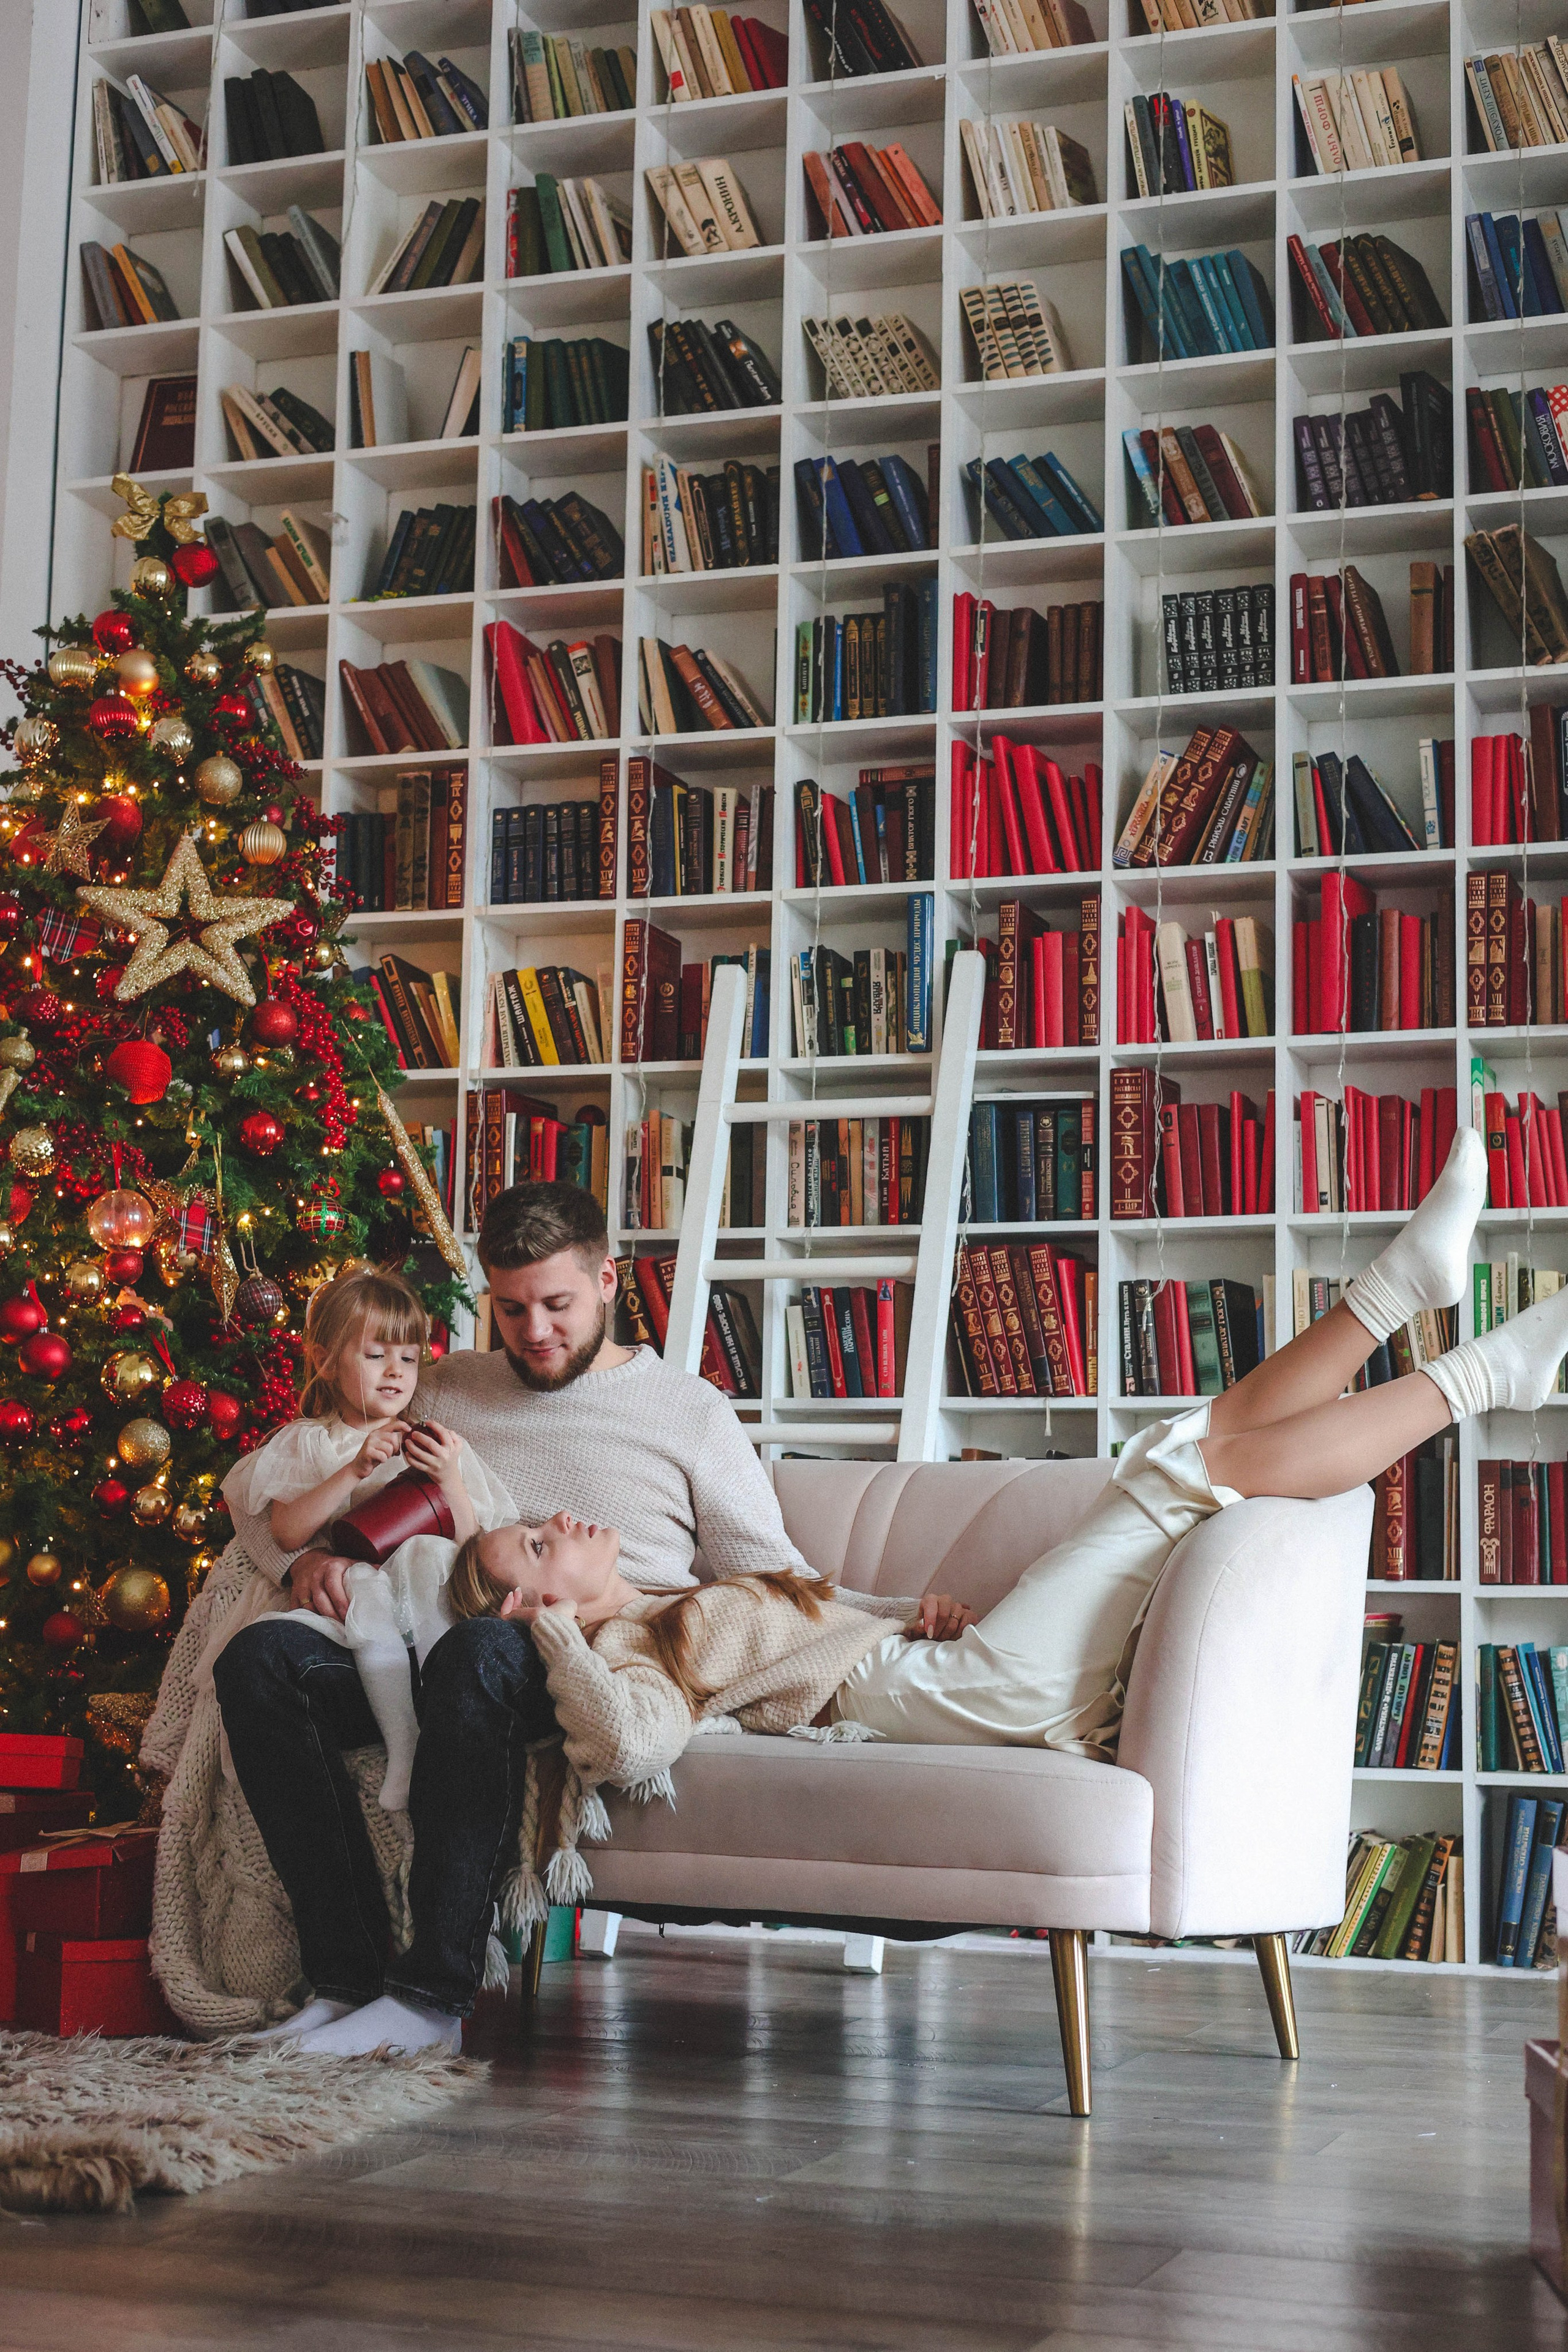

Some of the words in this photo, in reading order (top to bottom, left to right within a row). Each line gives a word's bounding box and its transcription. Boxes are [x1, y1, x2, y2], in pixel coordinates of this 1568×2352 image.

[1479, 75, 1493, 100] КЕНТ
[1313, 93, 1332, 132] ФОРШ
[1485, 100, 1504, 142] РОКУЭЛЛ
[1325, 132, 1342, 165] ОЛЬГА
[1008, 206, 1016, 216] 2
[1534, 414, 1560, 470] МОСКОВИЯ
[1206, 815, 1227, 849] РАФАЭЛЬ
[1218, 778, 1242, 817] САБАТИНИ
[1231, 815, 1254, 846] СТЮАРТ
[912, 940, 921, 964] ЧУДЕС
[744, 951, 758, 997] ТОЛСТЯКА
[496, 978, 506, 1008] КУХНЯ
[507, 983, 526, 1024] ШАНТАЖ
[911, 967, 920, 1031] ЭНЦИКЛОПЕДИЯ
[1474, 994, 1480, 1005] V
[1492, 993, 1502, 1004] VII
[745, 1001, 753, 1018] ТРИ
[1084, 1014, 1096, 1024] VIII
[1002, 1017, 1009, 1028] X
[499, 1009, 512, 1066] ЛАТЫШСКАЯ
[625, 1031, 633, 1041] IV
[1125, 1188, 1130, 1199] II
[717, 1312, 731, 1335] МОРЕ
[1215, 1299, 1226, 1325] ГЮГО
[724, 1334, 734, 1347] НА
[840, 1326, 850, 1353] ЗАКОНЫ
[842, 1309, 856, 1353] ПАРКИНСОНА
[1123, 1326, 1132, 1360] Сталин.
[1218, 1325, 1231, 1357] ВИКТОР
[728, 1346, 737, 1355] И
[813, 1336, 822, 1363] ПУШКИН
[730, 1353, 744, 1378] СУШЕ
[979, 1363, 988, 1374] VI
[1000, 1364, 1006, 1375] V
[1017, 1363, 1026, 1374] X
[1054, 1365, 1062, 1375] IV
[1088, 1355, 1096, 1393] КУРАНТЫ
[737, 1377, 748, 1390] НА
[1483, 1483, 1494, 1534] ФАРАОН
[1388, 1547, 1403, 1558] XIII
[1374, 1705, 1389, 1752] ФАНТАСТИКА
[1384, 1651, 1398, 1693] ДЕТЕКТИВ
